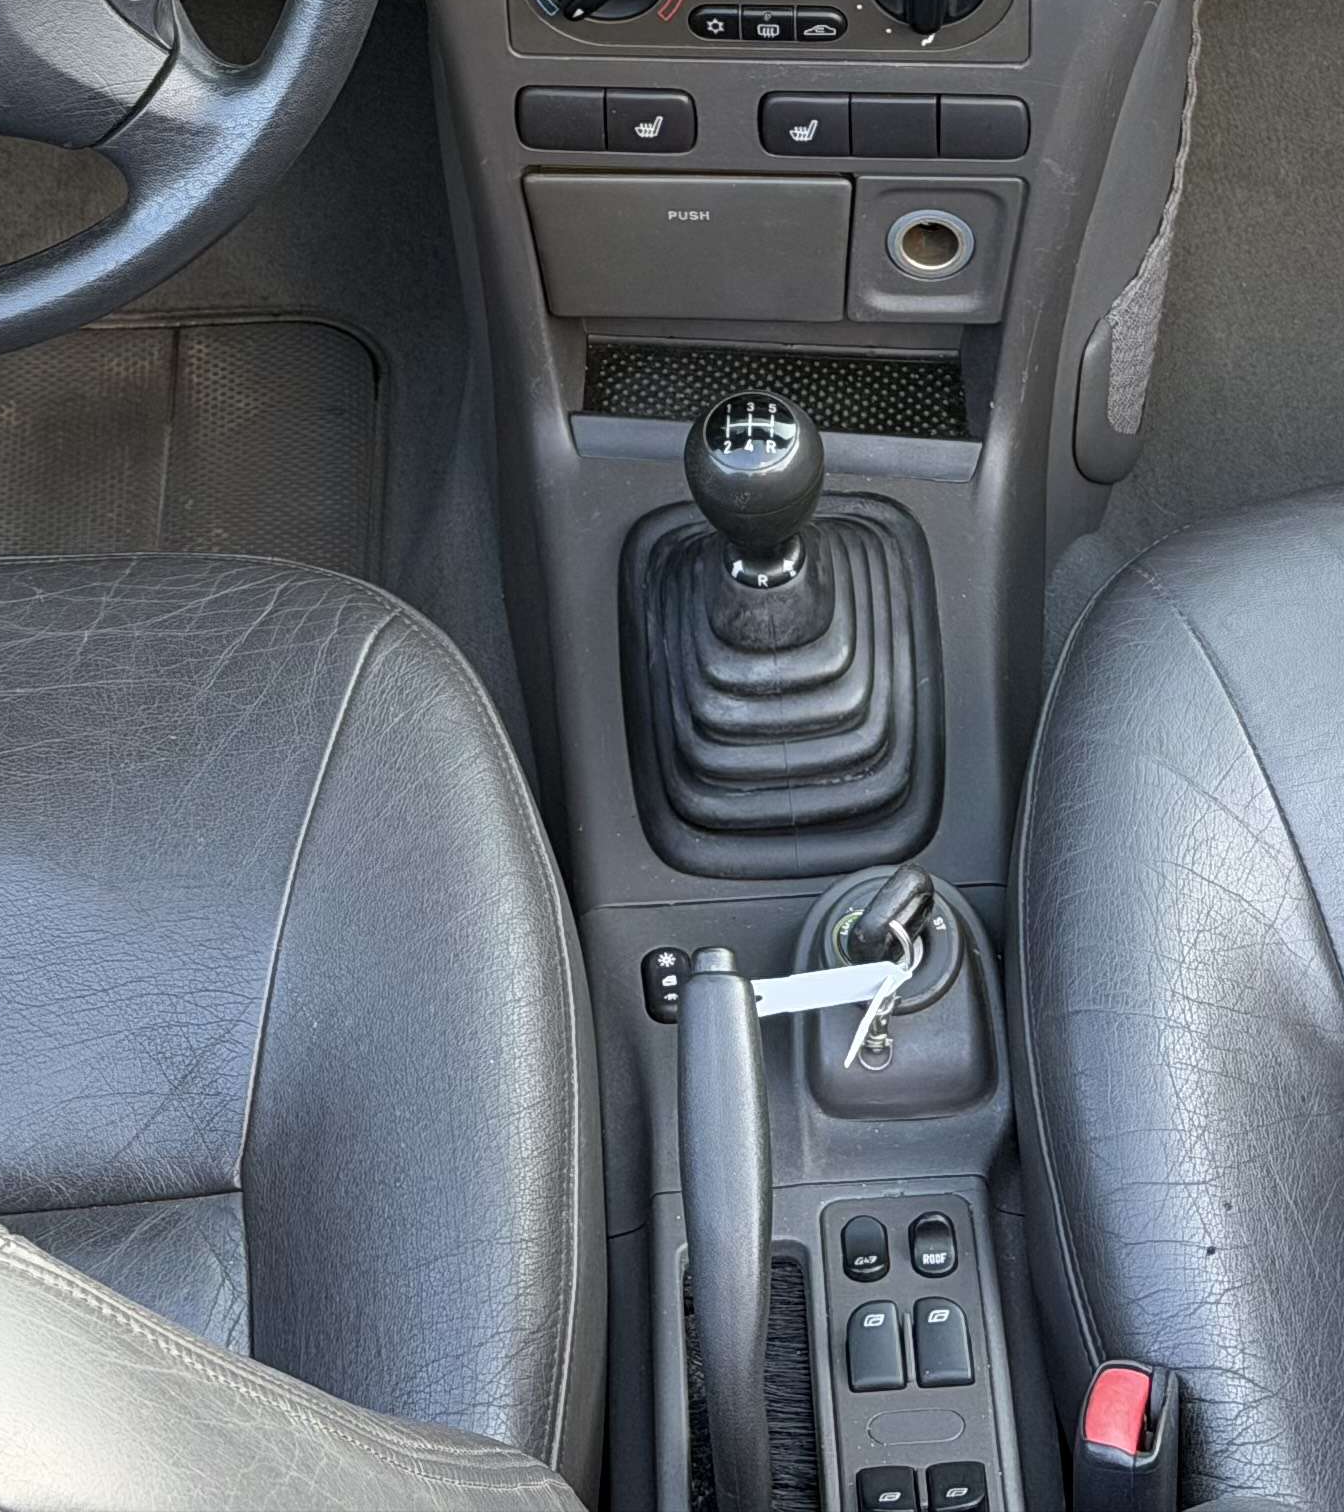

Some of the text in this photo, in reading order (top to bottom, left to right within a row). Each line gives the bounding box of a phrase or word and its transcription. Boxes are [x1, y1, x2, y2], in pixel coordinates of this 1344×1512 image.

[667, 210, 711, 221] PUSH
[726, 402, 777, 414] 1 3 5
[723, 439, 777, 455] 2 4 R
[757, 574, 768, 588] R
[922, 1252, 948, 1265] ROOF
